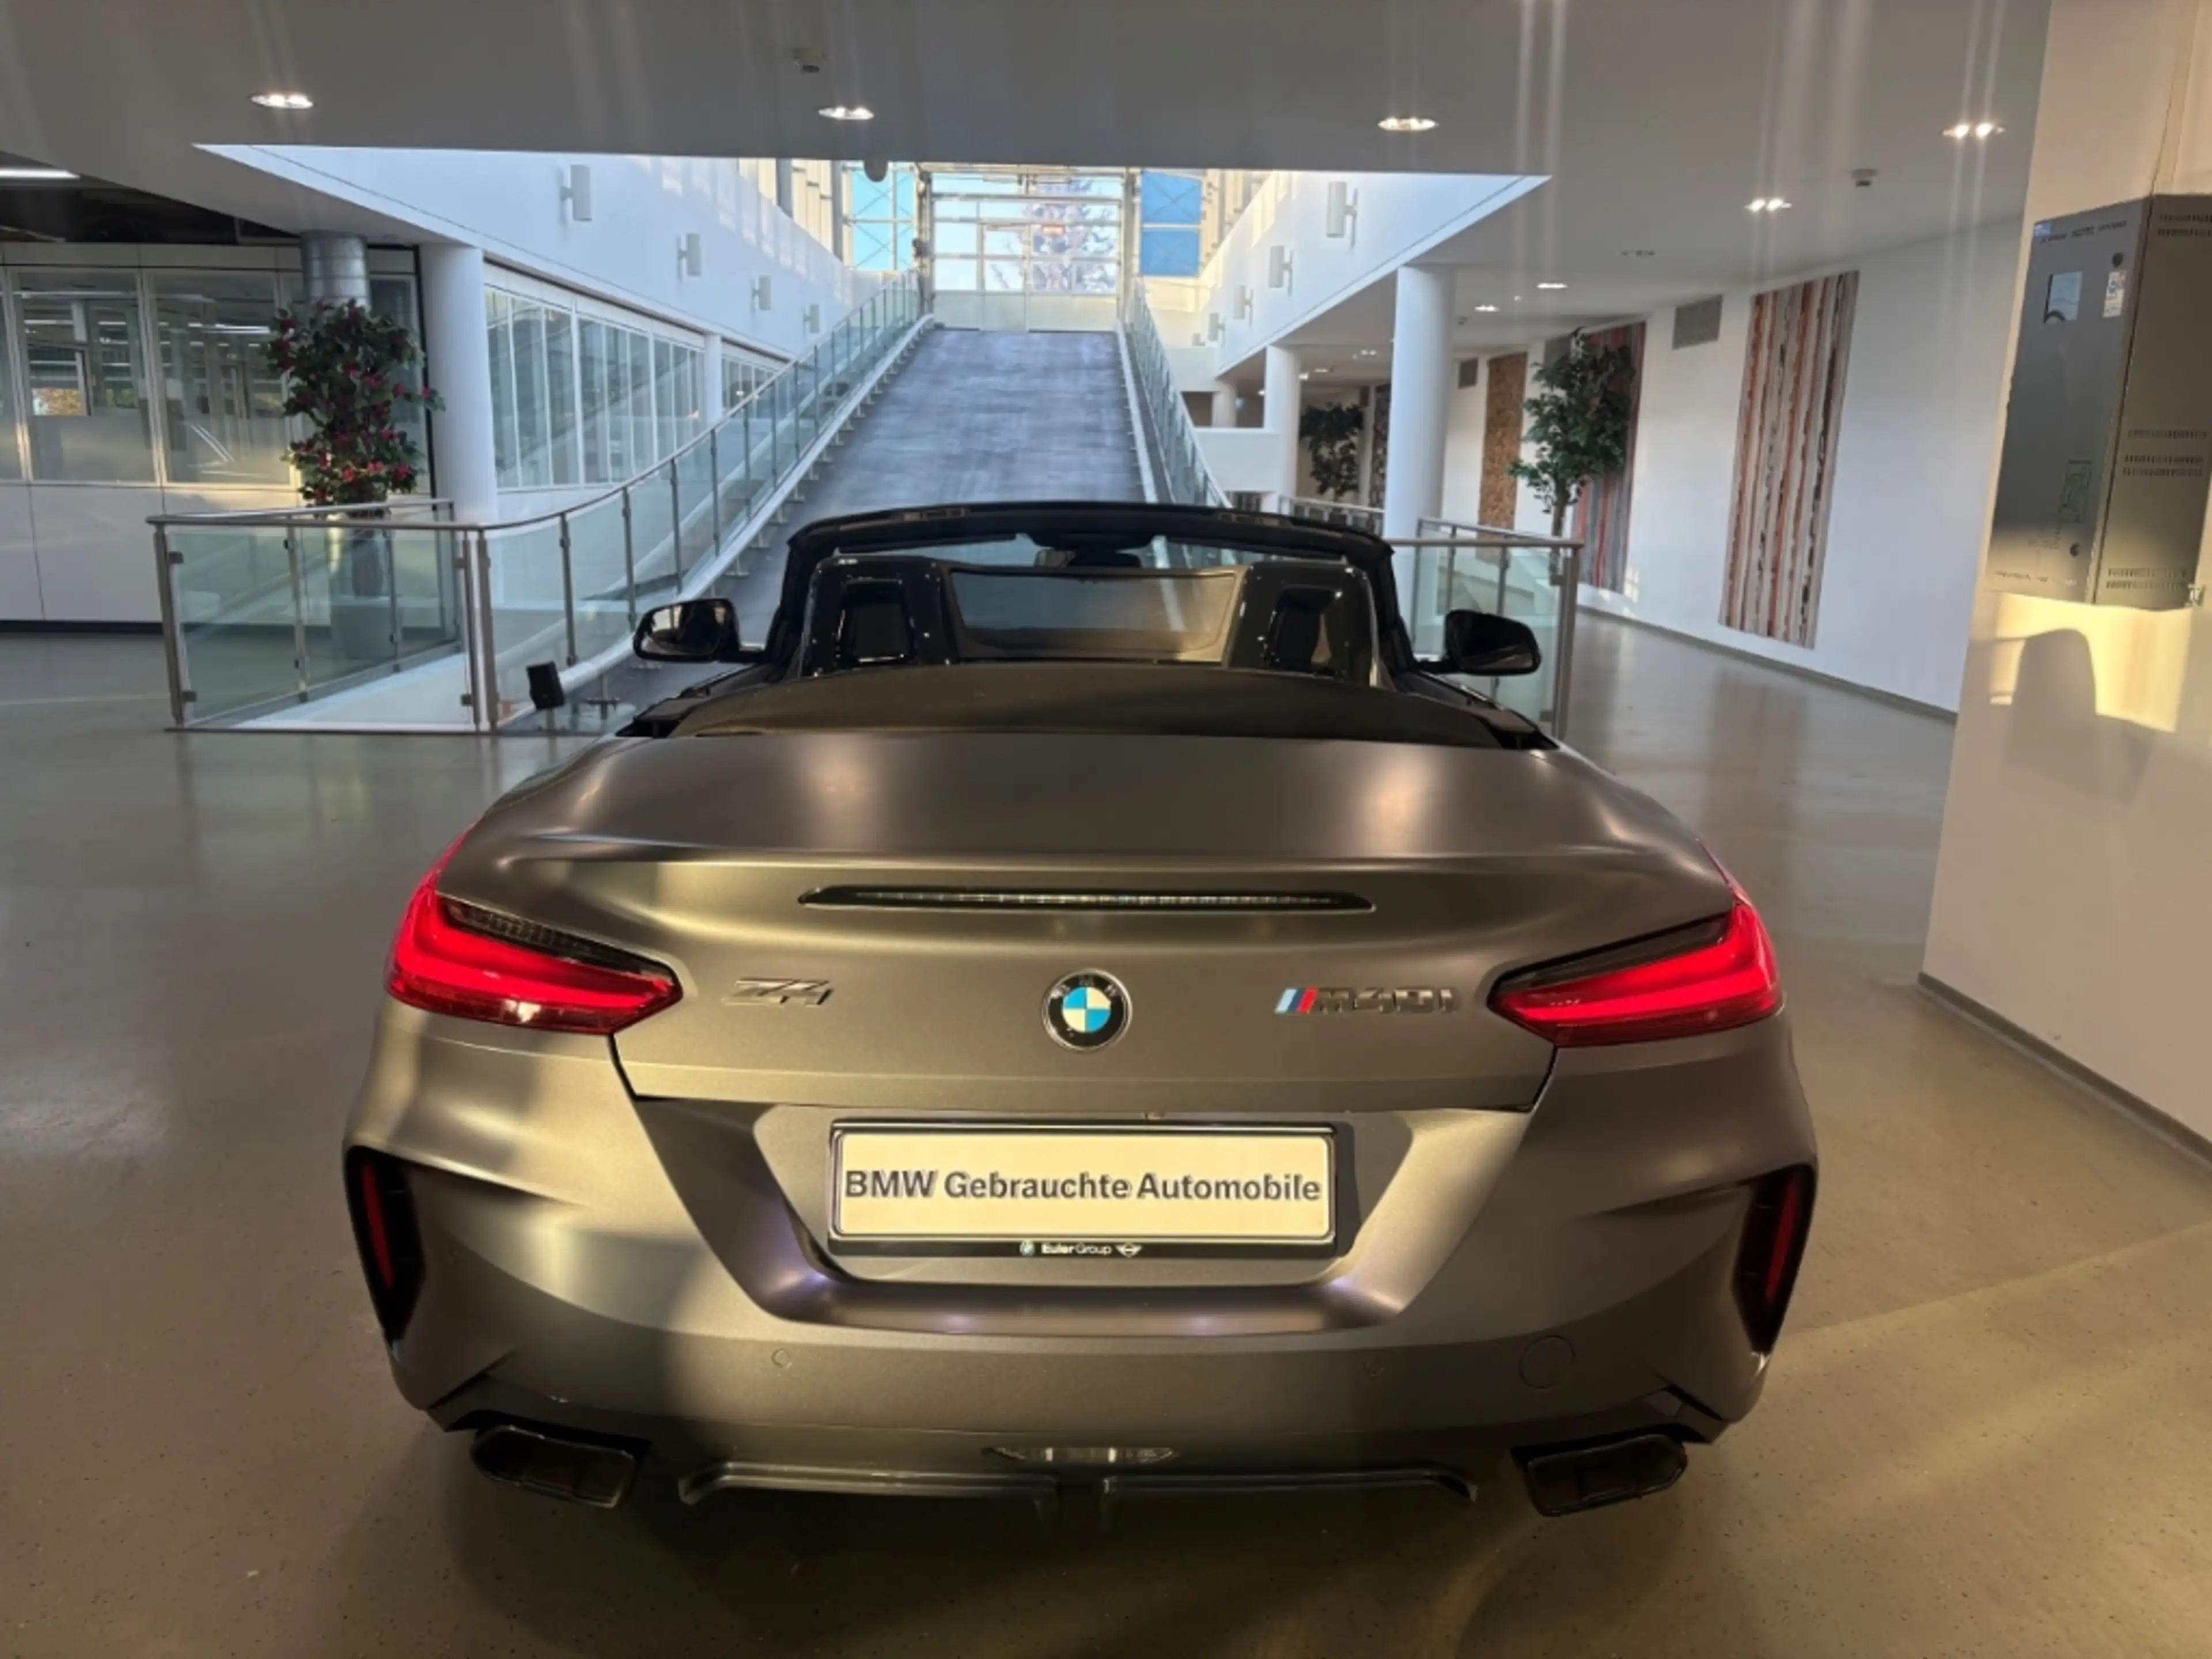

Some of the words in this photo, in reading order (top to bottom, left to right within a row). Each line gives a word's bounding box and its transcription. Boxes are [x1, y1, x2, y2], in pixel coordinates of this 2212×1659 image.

[845, 1169, 936, 1198] BMW
[944, 1171, 1130, 1199] Gebrauchte
[1137, 1172, 1321, 1201] Automobile
